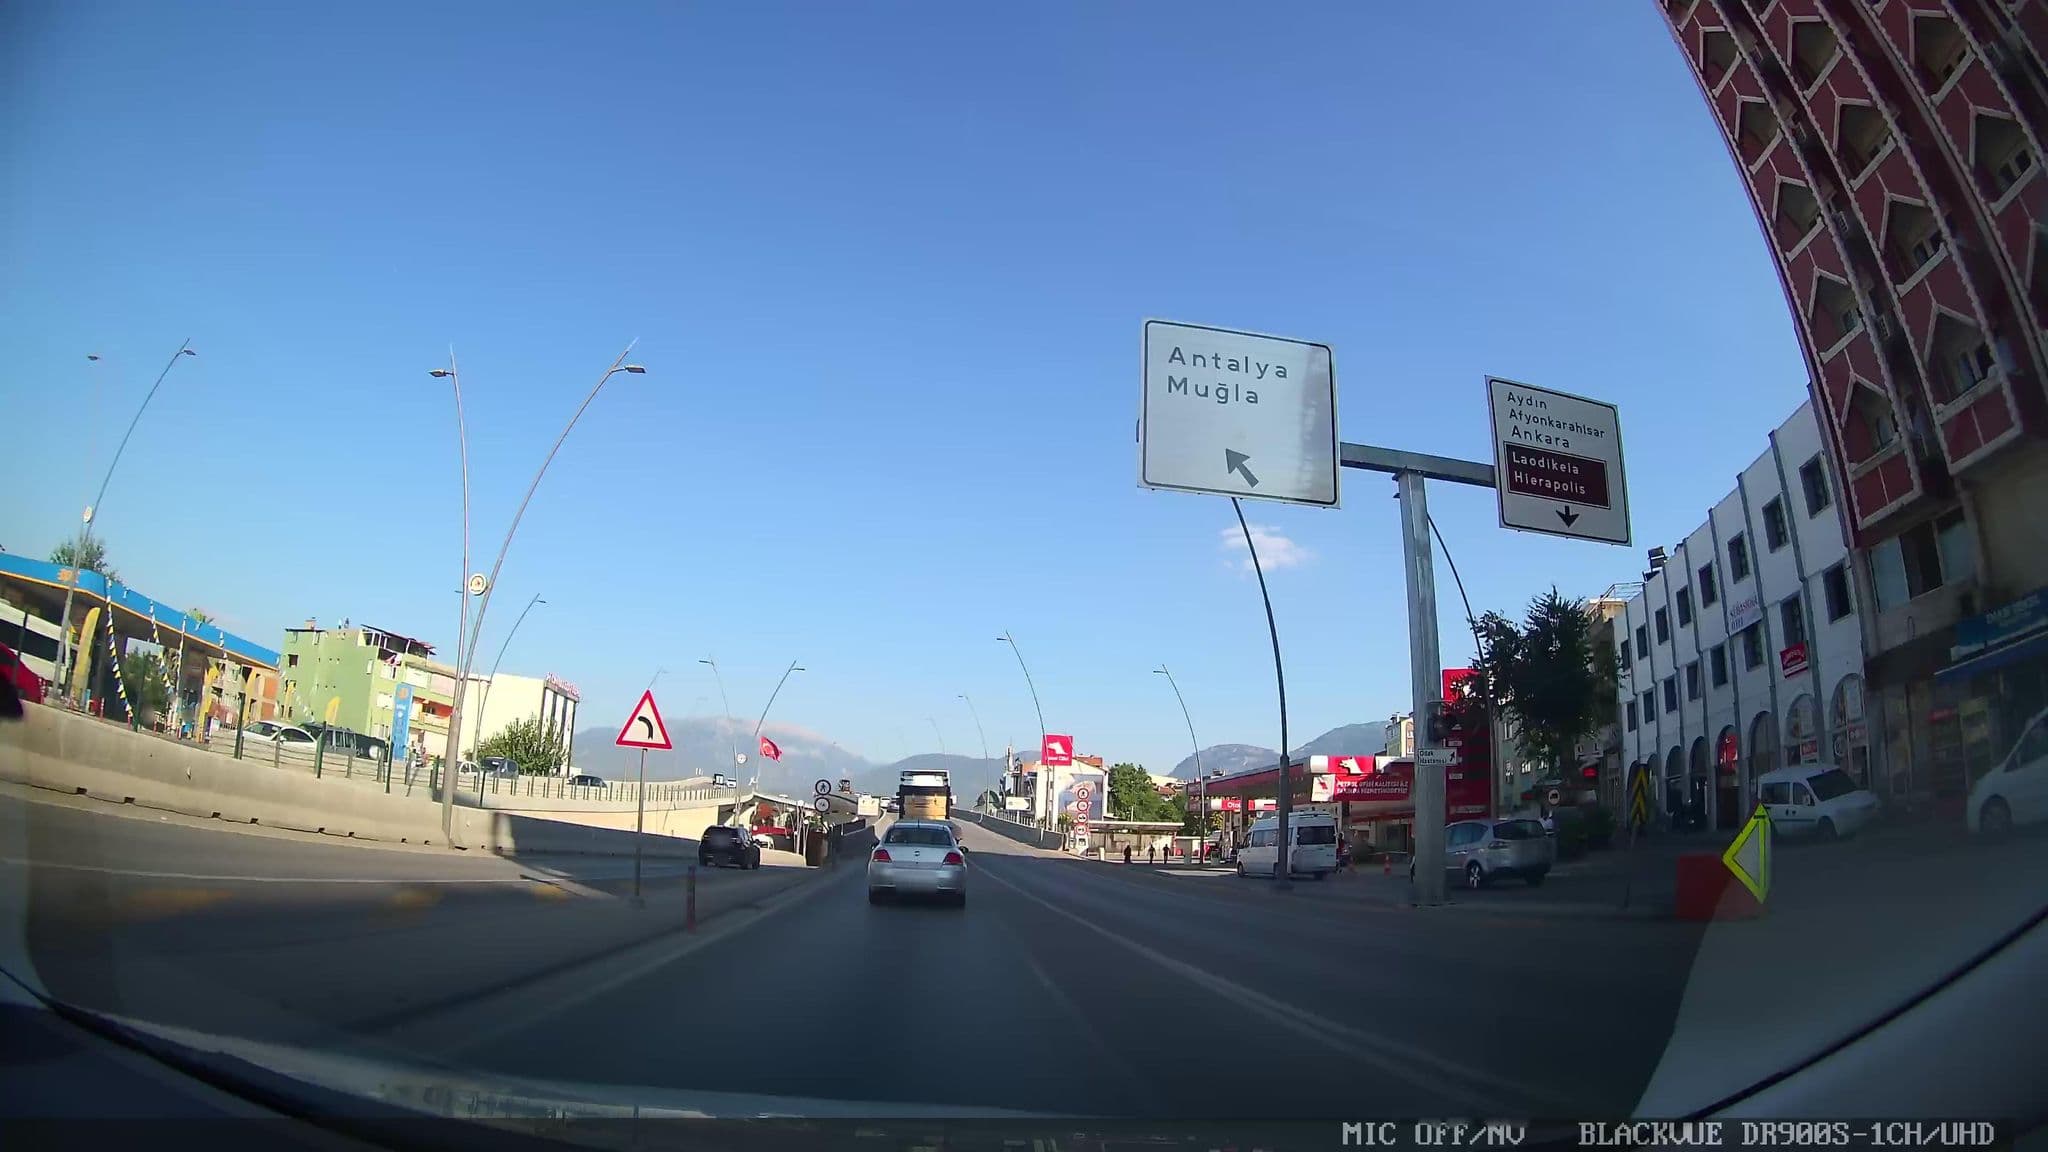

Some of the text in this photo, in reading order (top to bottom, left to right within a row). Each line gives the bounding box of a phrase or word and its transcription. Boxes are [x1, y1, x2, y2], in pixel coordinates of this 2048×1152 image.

[1168, 346, 1287, 379] Antalya
[1167, 375, 1259, 404] Muğla
[1507, 391, 1547, 410] Aydın
[1509, 408, 1605, 438] Afyonkarahisar
[1511, 425, 1570, 448] Ankara
[1514, 471, 1586, 495] Hierapolis
